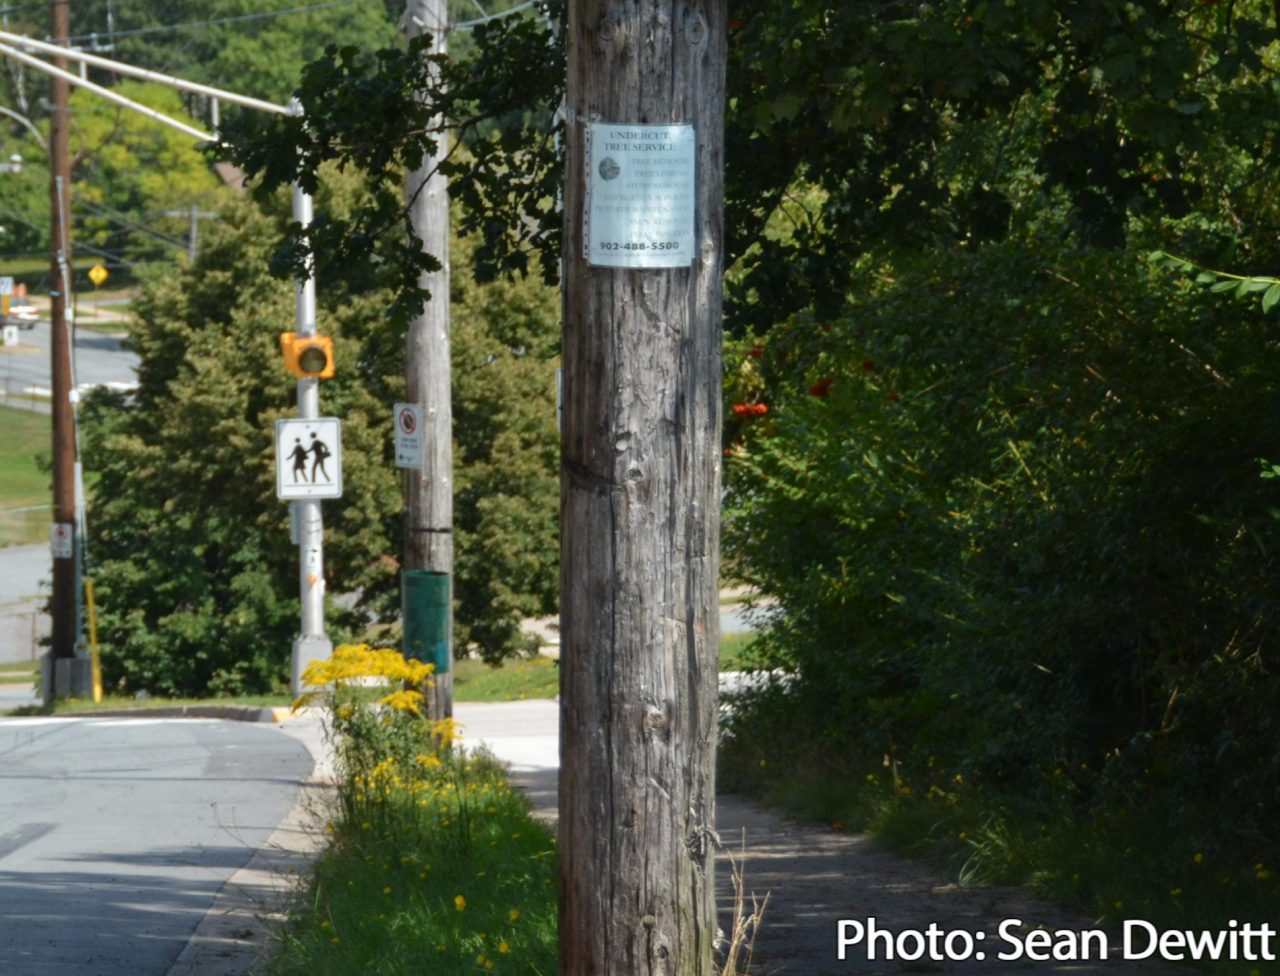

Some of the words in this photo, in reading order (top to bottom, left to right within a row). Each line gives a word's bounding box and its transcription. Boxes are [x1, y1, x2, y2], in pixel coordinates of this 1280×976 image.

[609, 131, 670, 140] UNDERCUT
[604, 143, 631, 152] TREE
[632, 142, 677, 152] SERVICE
[600, 241, 680, 251] 902-488-5500
